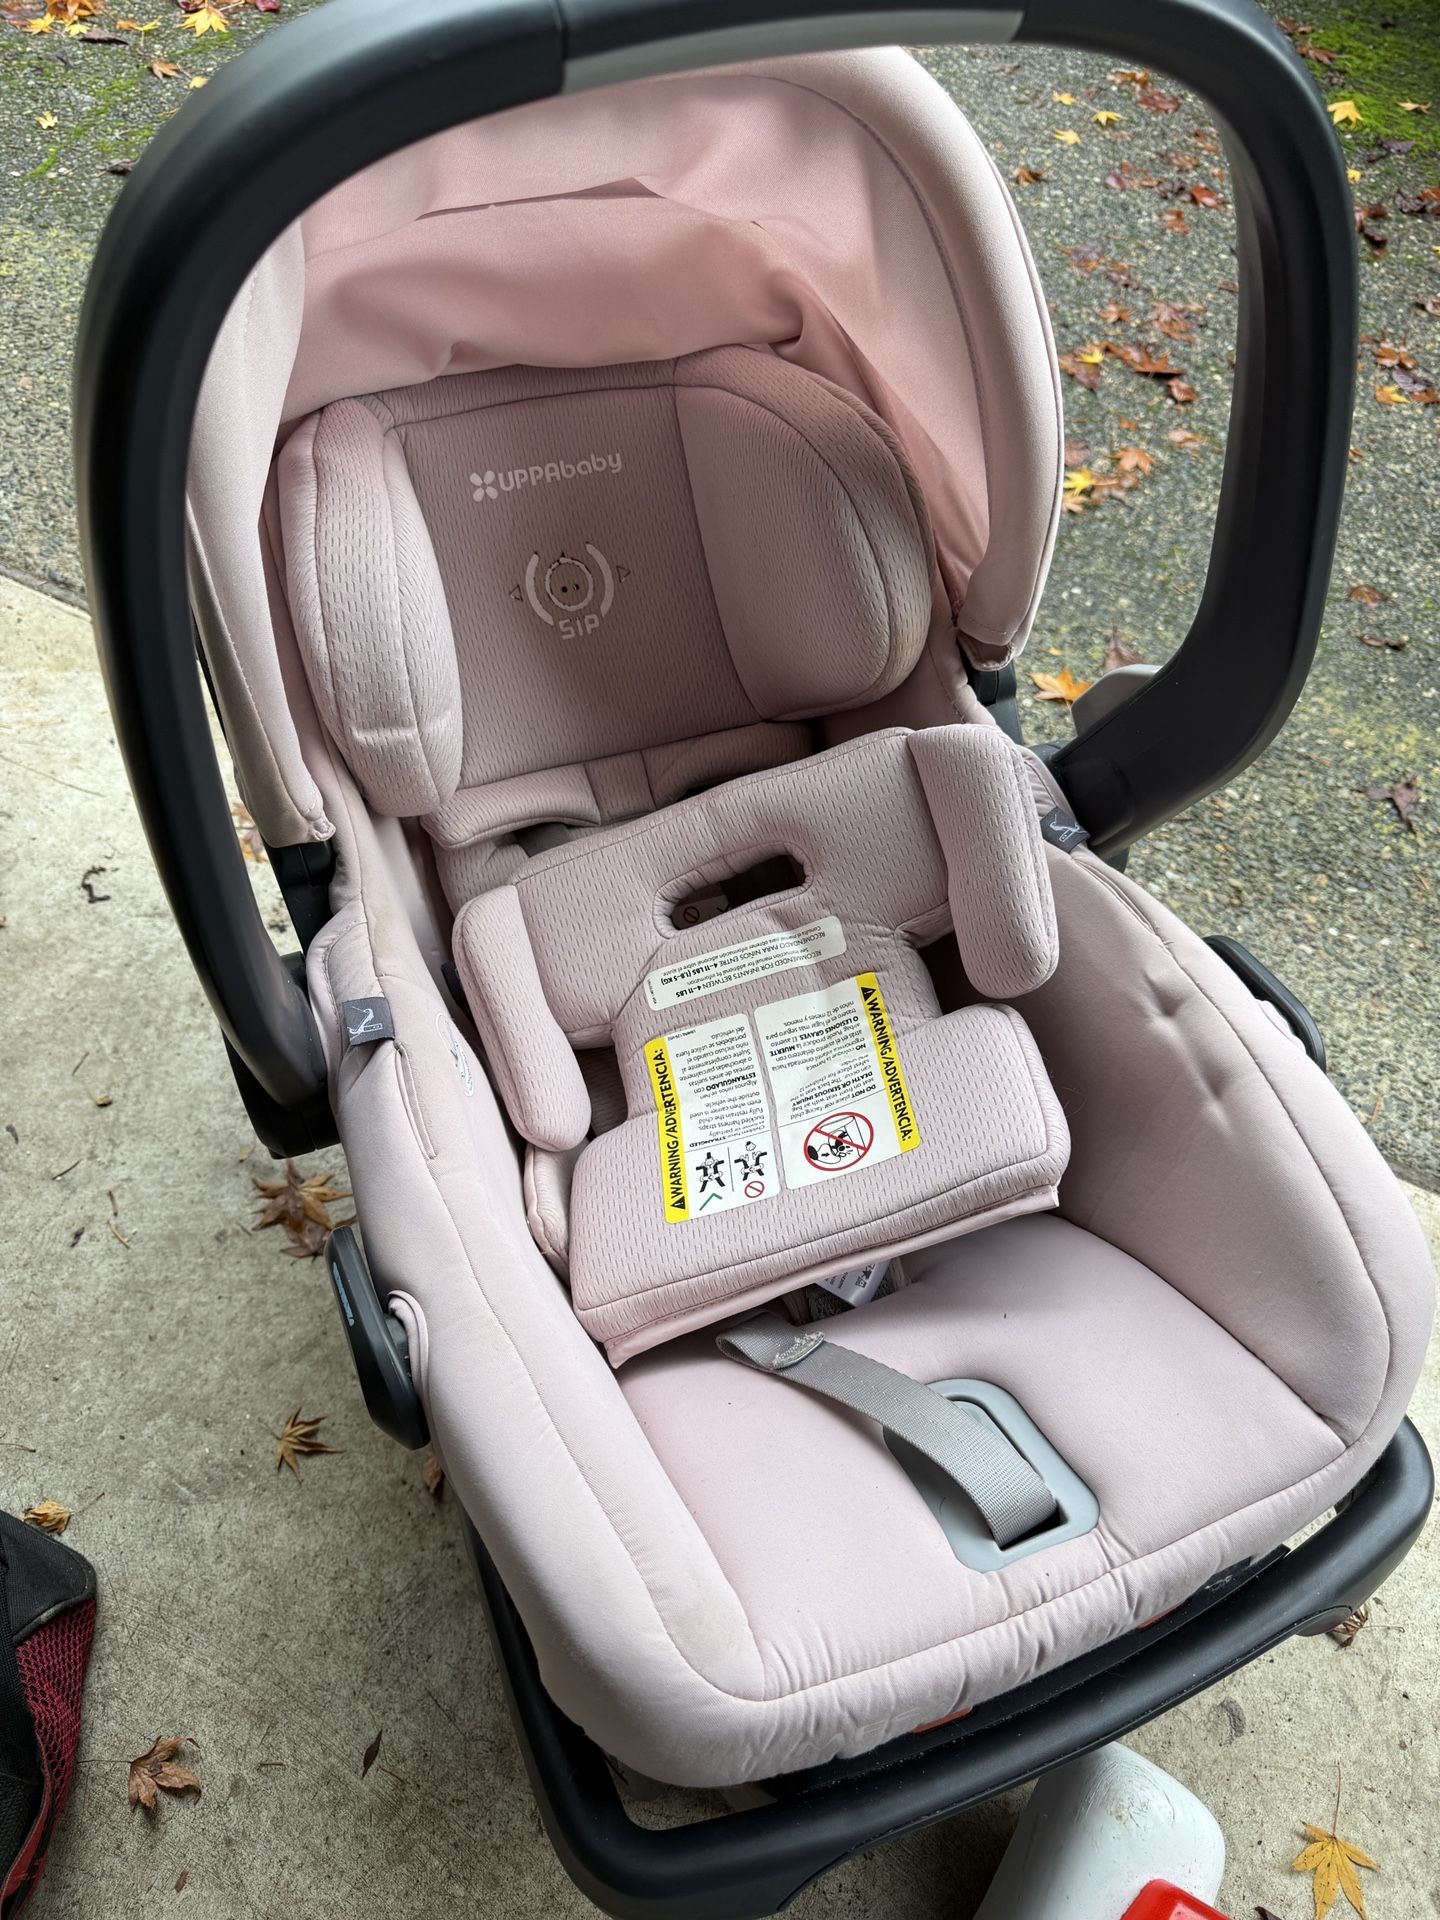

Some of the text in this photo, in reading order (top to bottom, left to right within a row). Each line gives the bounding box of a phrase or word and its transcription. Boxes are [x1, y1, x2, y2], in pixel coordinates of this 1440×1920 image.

[498, 453, 622, 491] UPPAbaby
[558, 614, 600, 640] SIP
[749, 940, 768, 949] obtener
[780, 931, 826, 948] RECOMENDADO
[719, 946, 748, 958] información
[761, 944, 779, 953] PARA
[739, 949, 761, 960] NIÑOS
[774, 949, 822, 966] RECOMMENDED
[697, 955, 718, 966] adicional
[719, 956, 739, 967] ENTRE
[755, 956, 773, 965] manual
[683, 962, 697, 970] sobre
[692, 967, 704, 975] LBS
[722, 963, 746, 975] additional
[760, 962, 774, 971] FOR
[732, 966, 760, 979] INFANTS
[660, 977, 673, 985] KG)
[702, 975, 732, 989] BETWEEN
[675, 989, 688, 998] LBS
[839, 1000, 854, 1009] niños
[837, 1008, 856, 1019] trasero
[784, 1018, 803, 1026] menos.
[811, 1020, 825, 1028] lugar
[824, 1018, 852, 1033] LESIONES
[735, 1026, 745, 1034] del
[778, 1028, 798, 1036] seguro
[715, 1033, 747, 1046] portabebés
[765, 1032, 778, 1040] para
[803, 1035, 826, 1047] producir
[770, 1038, 791, 1047] asiento
[815, 1041, 835, 1052] asiento
[855, 1043, 866, 1051] NO
[675, 1050, 690, 1058] fuera
[690, 1044, 708, 1054] utilice
[714, 1045, 735, 1055] incluso
[733, 1048, 751, 1058] Sujete
[770, 1045, 795, 1056] MUERTE
[787, 1048, 815, 1059] delantero
[693, 1051, 714, 1061] cuando
[688, 1054, 732, 1070] completamente
[715, 1058, 747, 1070] abrochadas
[787, 1057, 814, 1067] orientada
[806, 1059, 826, 1071] hamaca
[853, 1059, 870, 1068] safest
[732, 1064, 754, 1073] correas
[837, 1064, 852, 1074] place
[865, 997, 912, 1142] WARNING/ADVERTENCIA:
[708, 1072, 724, 1081] arnés
[844, 1069, 860, 1079] occur.
[688, 1077, 708, 1087] sueltas
[706, 1072, 756, 1091] ESTRANGULADO
[734, 1080, 757, 1089] Algunos
[817, 1081, 831, 1090] back
[862, 1077, 874, 1086] seat
[792, 1071, 873, 1108] DEATH OR SERIOUS INJURY
[805, 1087, 816, 1095] seat
[839, 1086, 853, 1096] front
[738, 1091, 760, 1100] outside
[826, 1093, 838, 1101] seat
[729, 1102, 746, 1110] when
[790, 1084, 876, 1120] DO NOT place rear-facing child
[811, 1098, 825, 1106] with
[710, 1106, 729, 1114] carrier
[725, 1110, 748, 1118] restrain
[655, 1048, 685, 1200] WARNING/ADVERTENCIA:
[698, 1116, 714, 1124] child
[717, 1120, 740, 1128] harness
[741, 1115, 765, 1124] buckled
[709, 1128, 733, 1137] partially
[689, 1136, 726, 1148] STRANGLED
